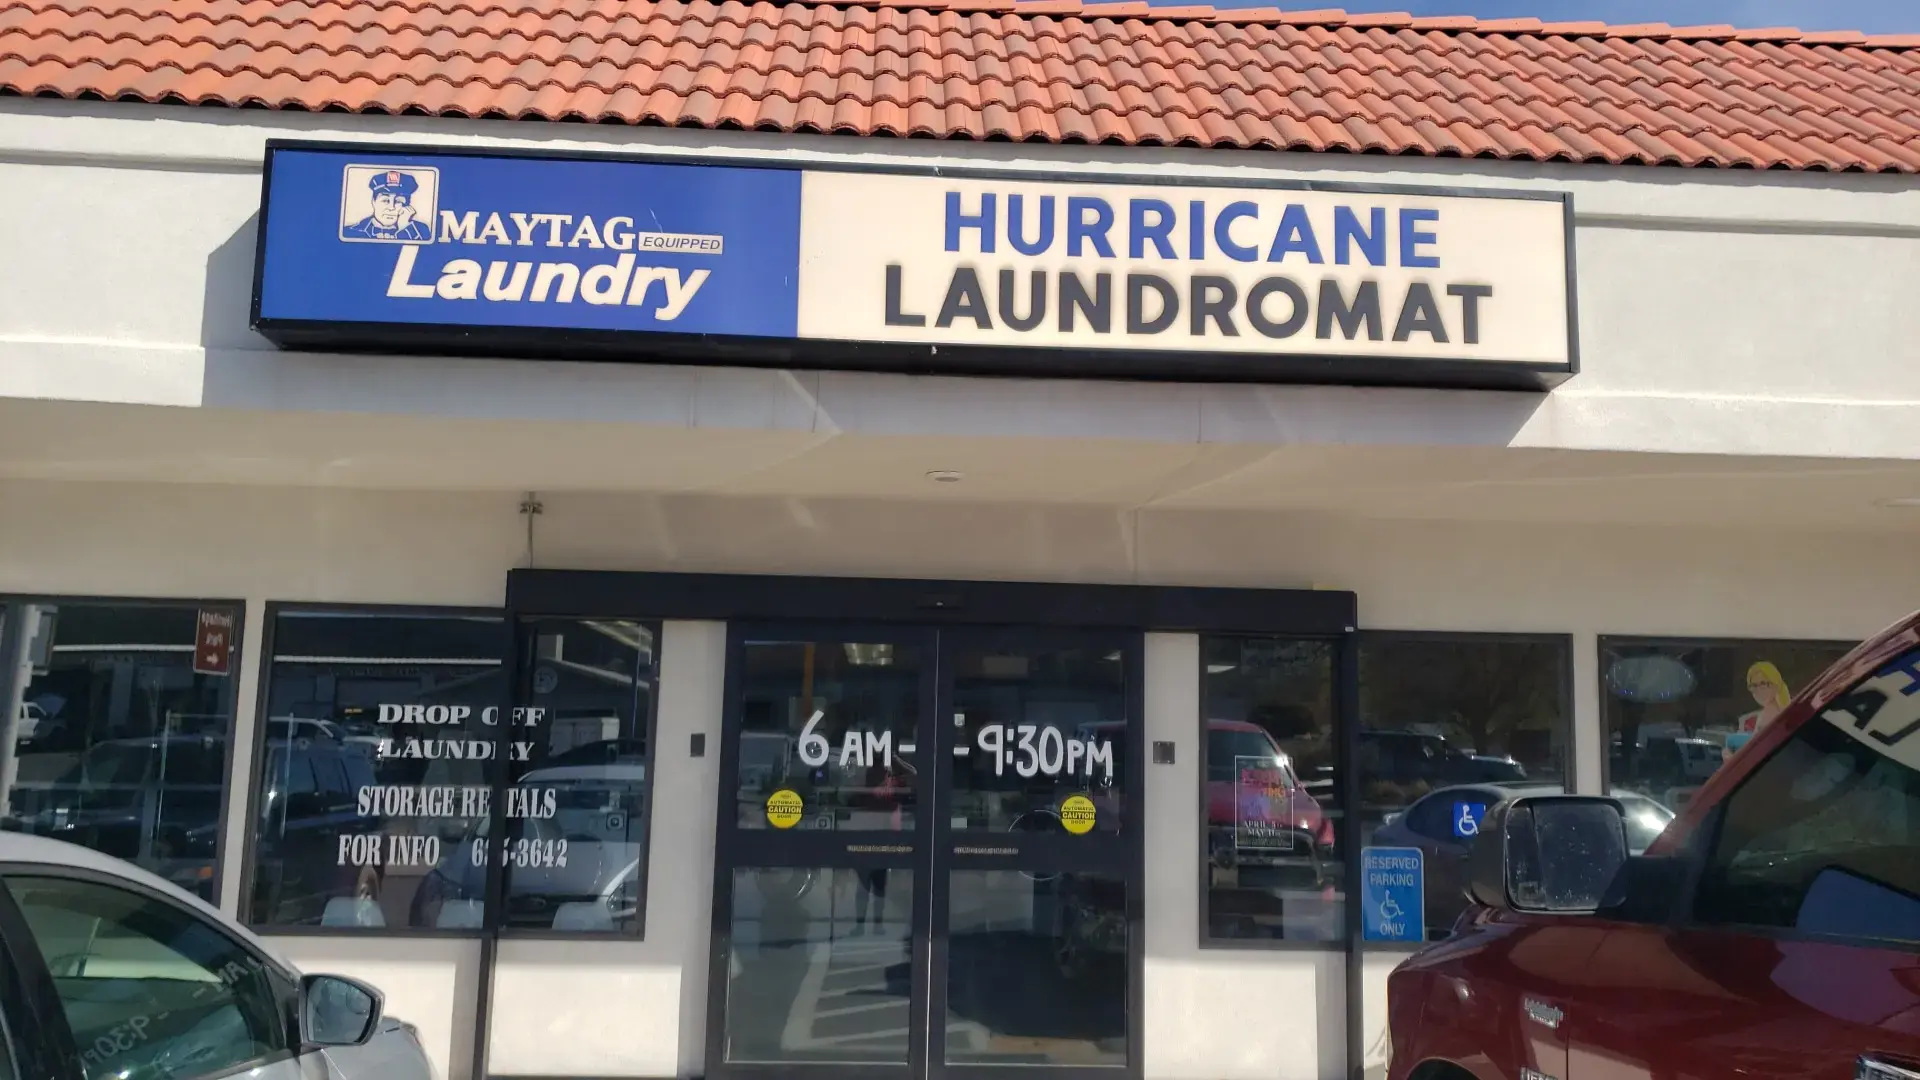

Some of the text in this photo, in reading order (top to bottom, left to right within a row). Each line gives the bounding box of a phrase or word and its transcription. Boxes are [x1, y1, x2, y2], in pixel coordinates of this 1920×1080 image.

[438, 210, 721, 251] MAYTAG EQUIPPED
[944, 191, 1441, 268] HURRICANE
[386, 245, 710, 321] Laundry
[885, 264, 1492, 344] LAUNDROMAT
[377, 703, 471, 725] DROP
[799, 710, 829, 767] 6
[357, 786, 557, 819] STORAGE RETALS
[768, 805, 802, 813] CAUTION
[1062, 811, 1095, 820] CAUTION
[337, 834, 381, 867] FOR
[387, 835, 440, 867] INFO
[1364, 856, 1419, 869] RESERVED
[1370, 873, 1414, 887] PARKING
[1380, 923, 1405, 936] ONLY
